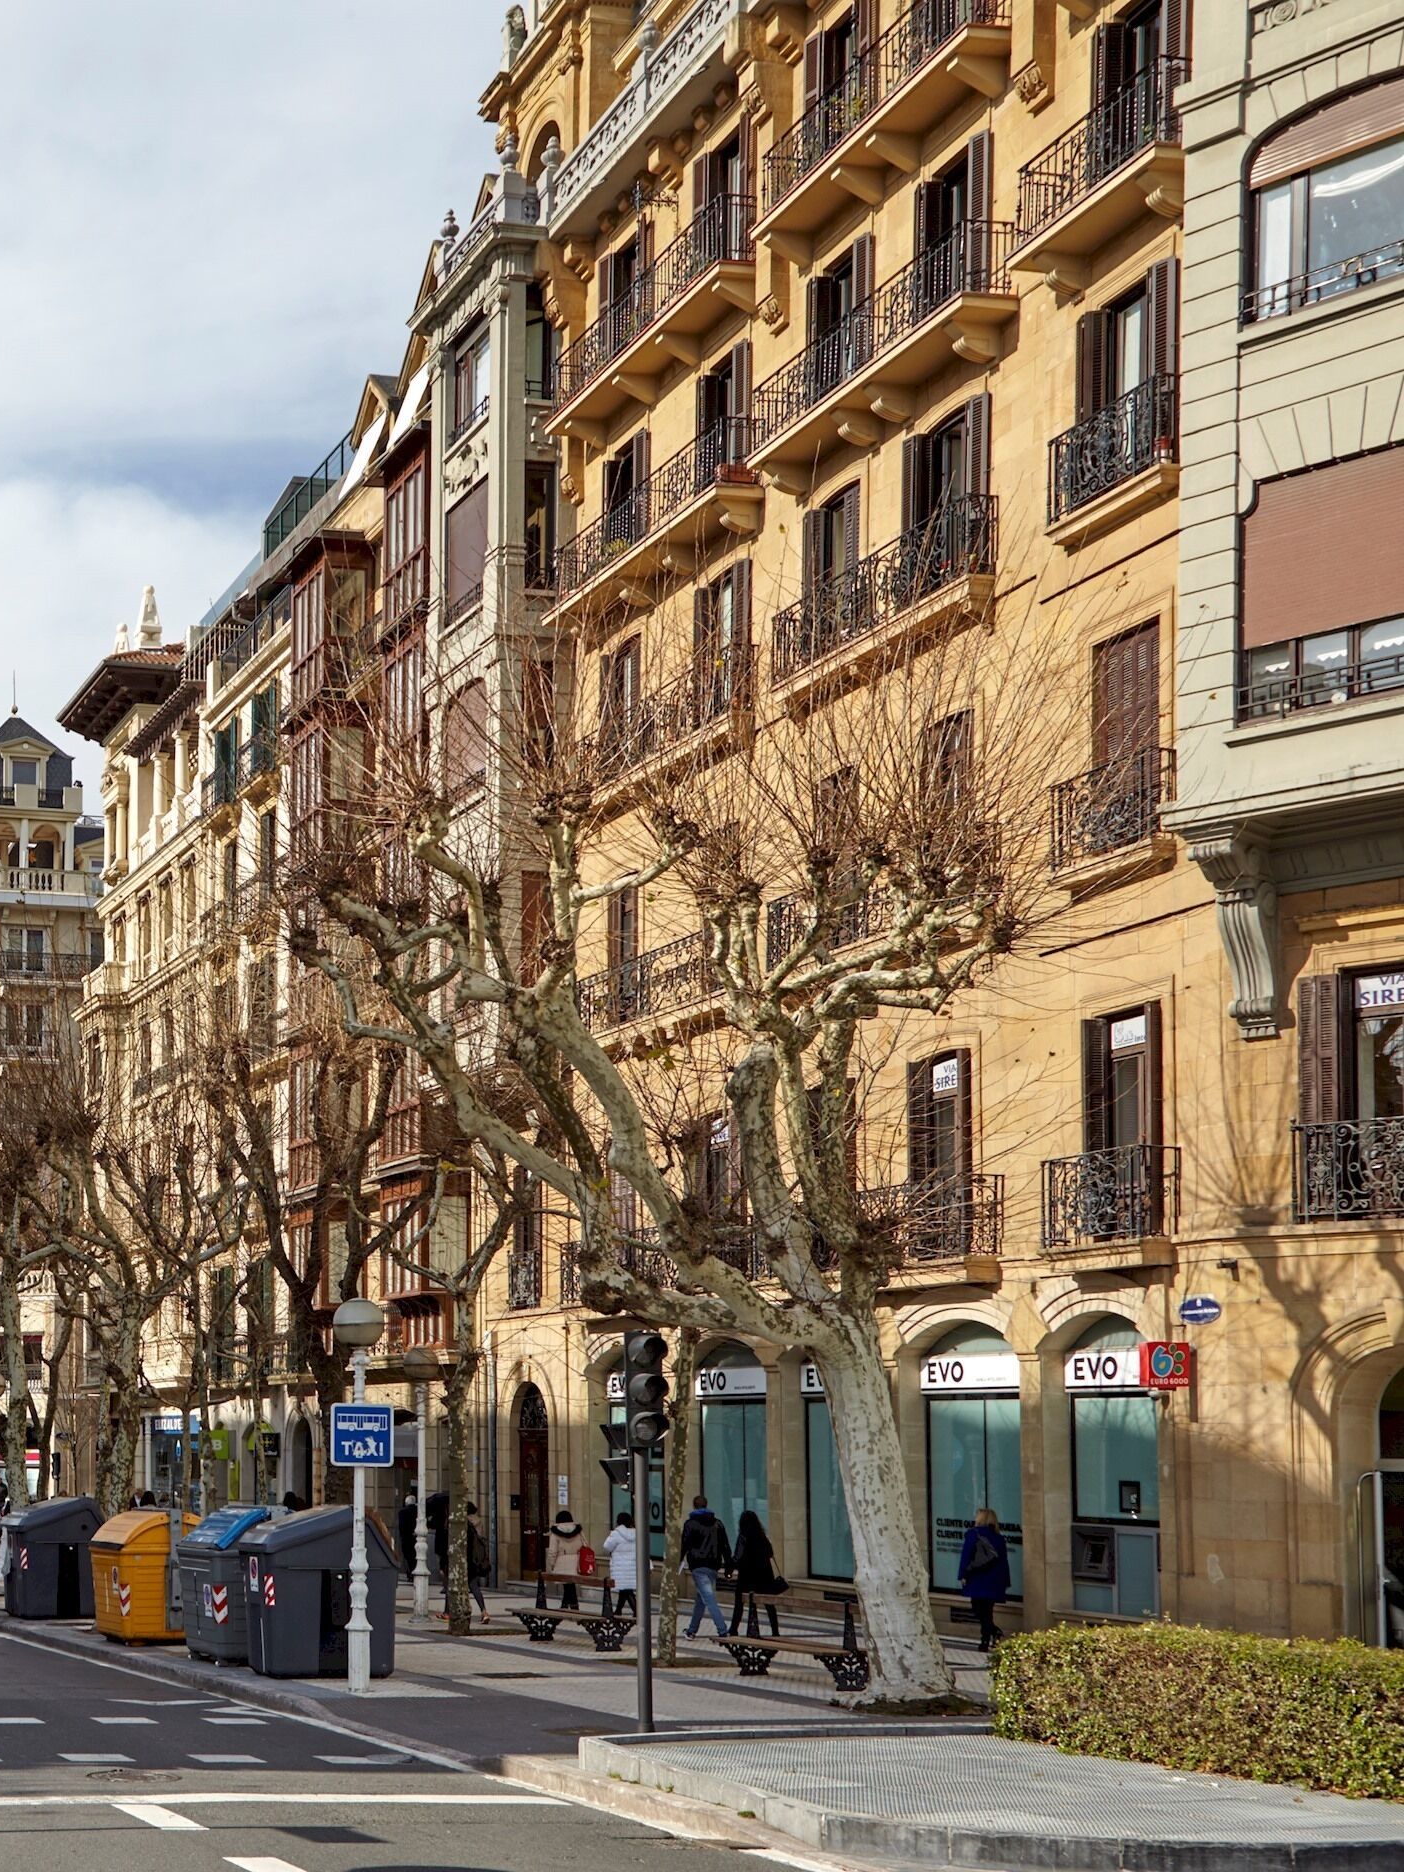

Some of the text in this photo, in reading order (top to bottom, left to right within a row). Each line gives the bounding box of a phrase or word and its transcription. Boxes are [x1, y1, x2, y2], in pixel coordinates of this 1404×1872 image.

[928, 1361, 964, 1383] EVO
[1074, 1356, 1117, 1380] EVO
[611, 1376, 626, 1393] EV
[700, 1371, 726, 1391] EVO
[1150, 1377, 1189, 1385] EURO 6000
[341, 1441, 384, 1457] TAXI
